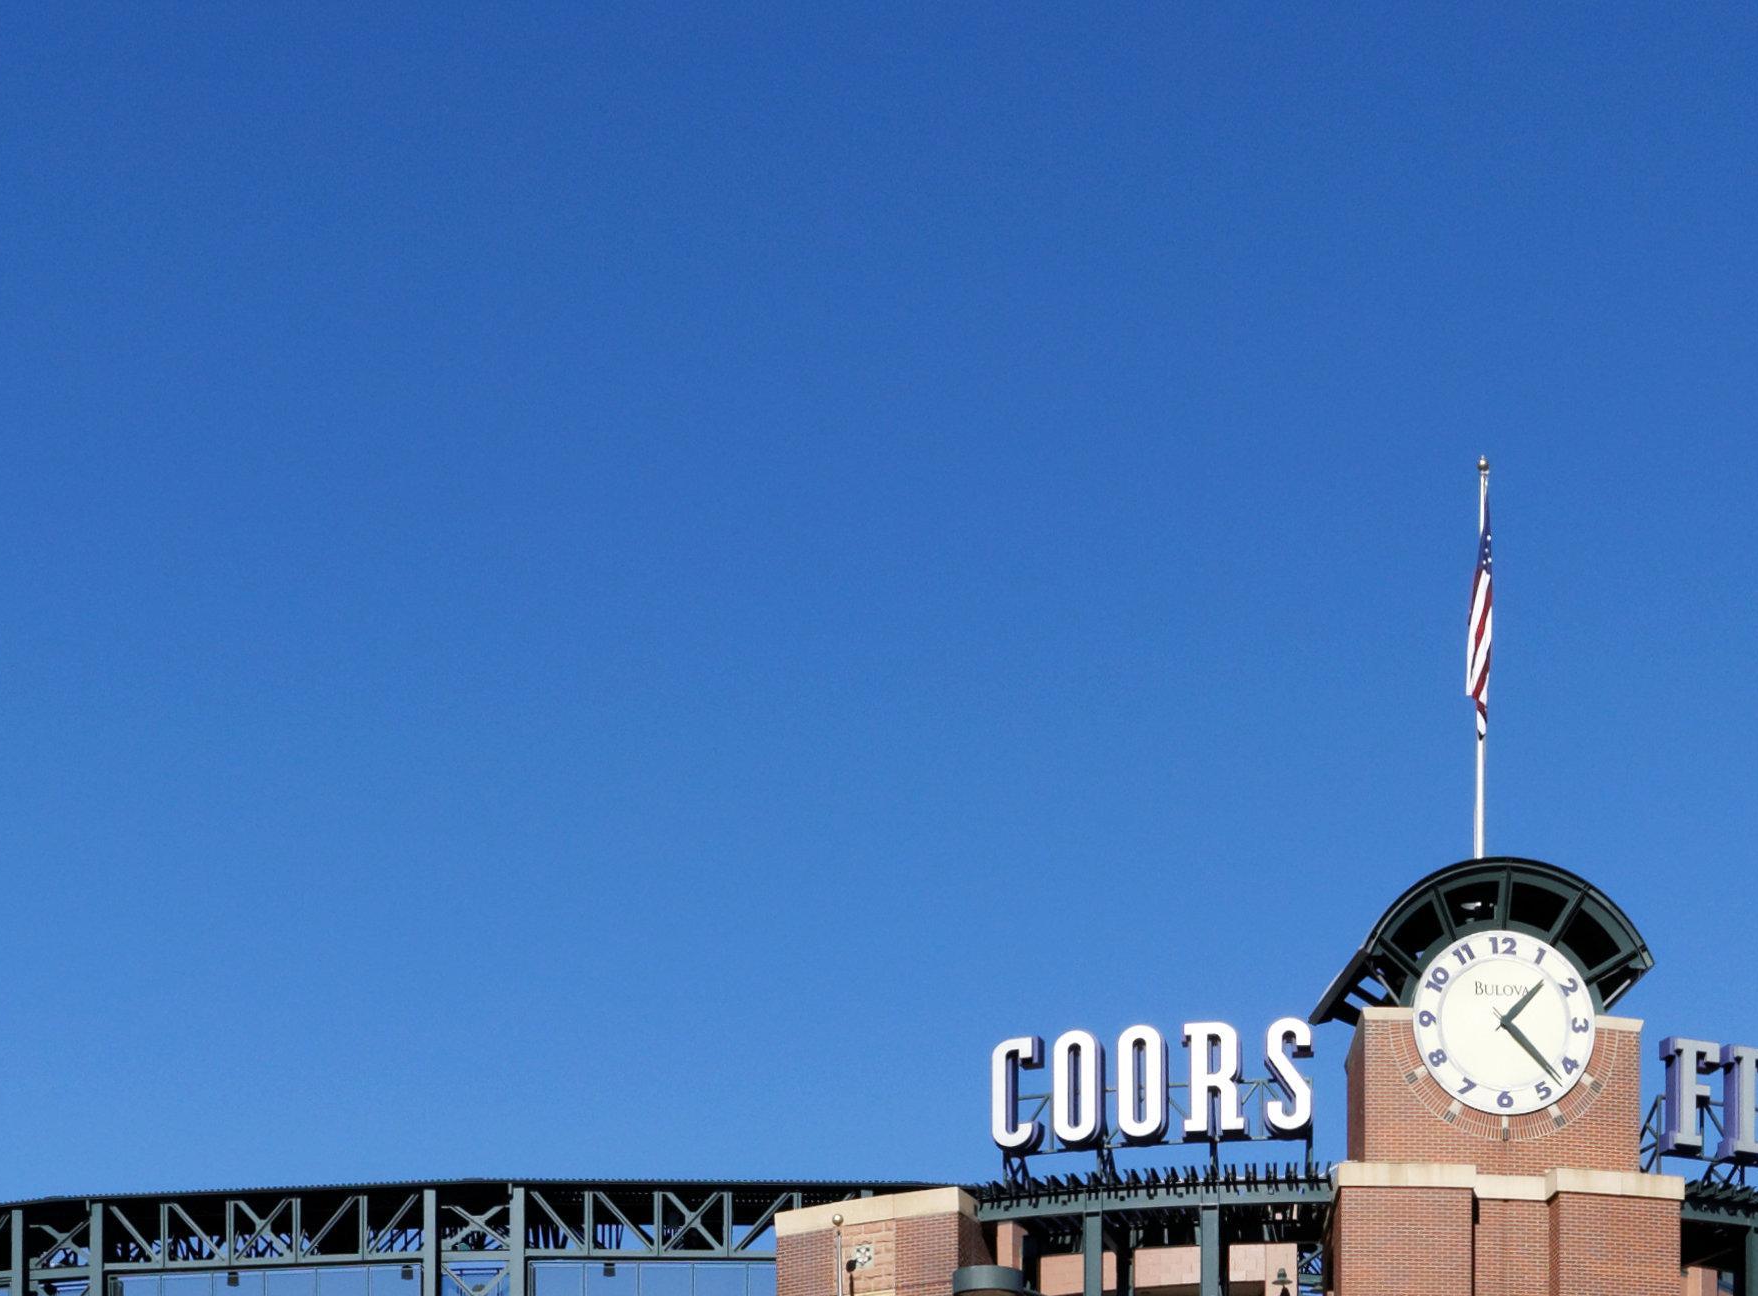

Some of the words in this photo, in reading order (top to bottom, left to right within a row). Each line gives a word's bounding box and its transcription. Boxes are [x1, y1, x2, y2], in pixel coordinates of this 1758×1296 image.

[1452, 943, 1475, 965] 11
[1489, 937, 1517, 955] 12
[1534, 947, 1547, 965] 1
[1425, 967, 1449, 993] 10
[1559, 978, 1579, 997] 2
[1418, 1010, 1437, 1028] 9
[1572, 1017, 1589, 1033] 3
[1429, 1049, 1448, 1067] 8
[1561, 1056, 1579, 1075] 4
[992, 1018, 1314, 1149] COORS
[1457, 1077, 1477, 1094] 7
[1535, 1081, 1552, 1101] 5
[1496, 1091, 1514, 1108] 6
